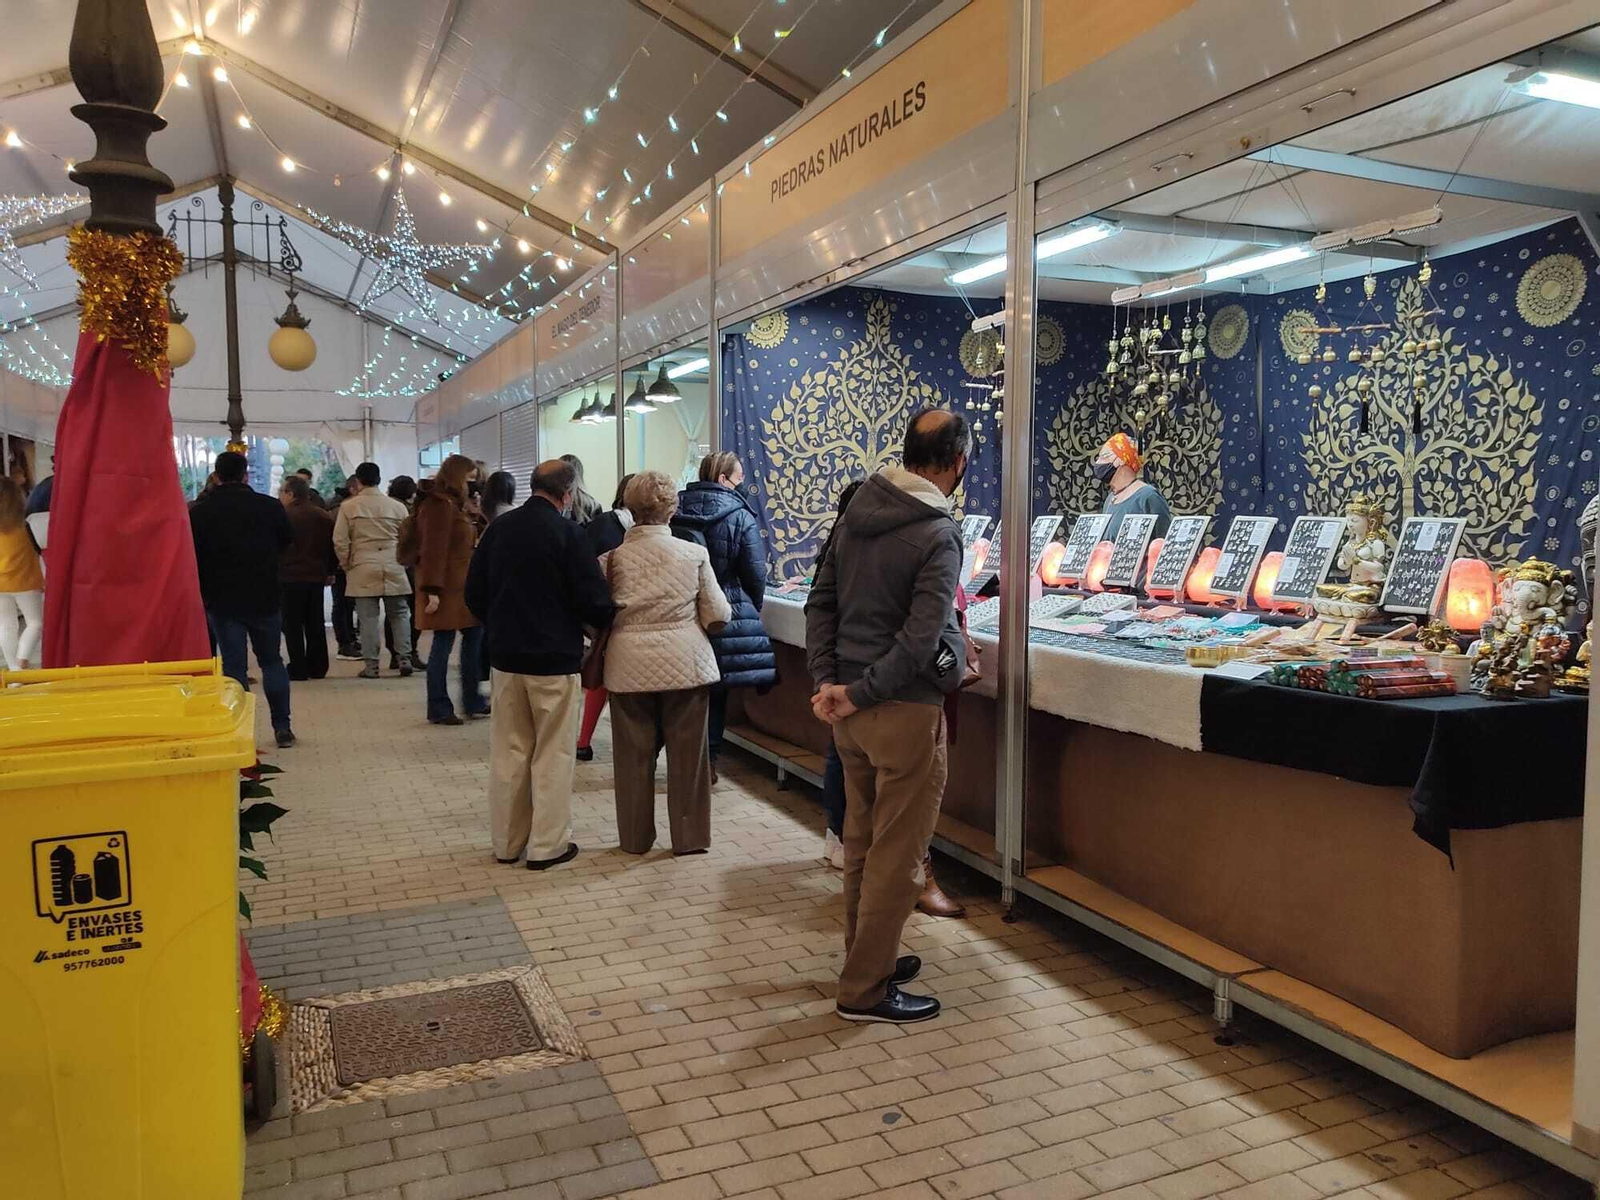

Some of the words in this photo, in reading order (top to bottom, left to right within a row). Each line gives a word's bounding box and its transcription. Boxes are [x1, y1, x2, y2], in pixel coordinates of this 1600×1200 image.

[771, 149, 824, 203] PIEDRAS
[829, 81, 927, 168] NATURALES
[68, 911, 142, 929] ENVASES
[66, 930, 76, 941] E
[81, 922, 143, 939] INERTES
[51, 948, 90, 960] sadeco
[63, 956, 125, 972] 957762000
